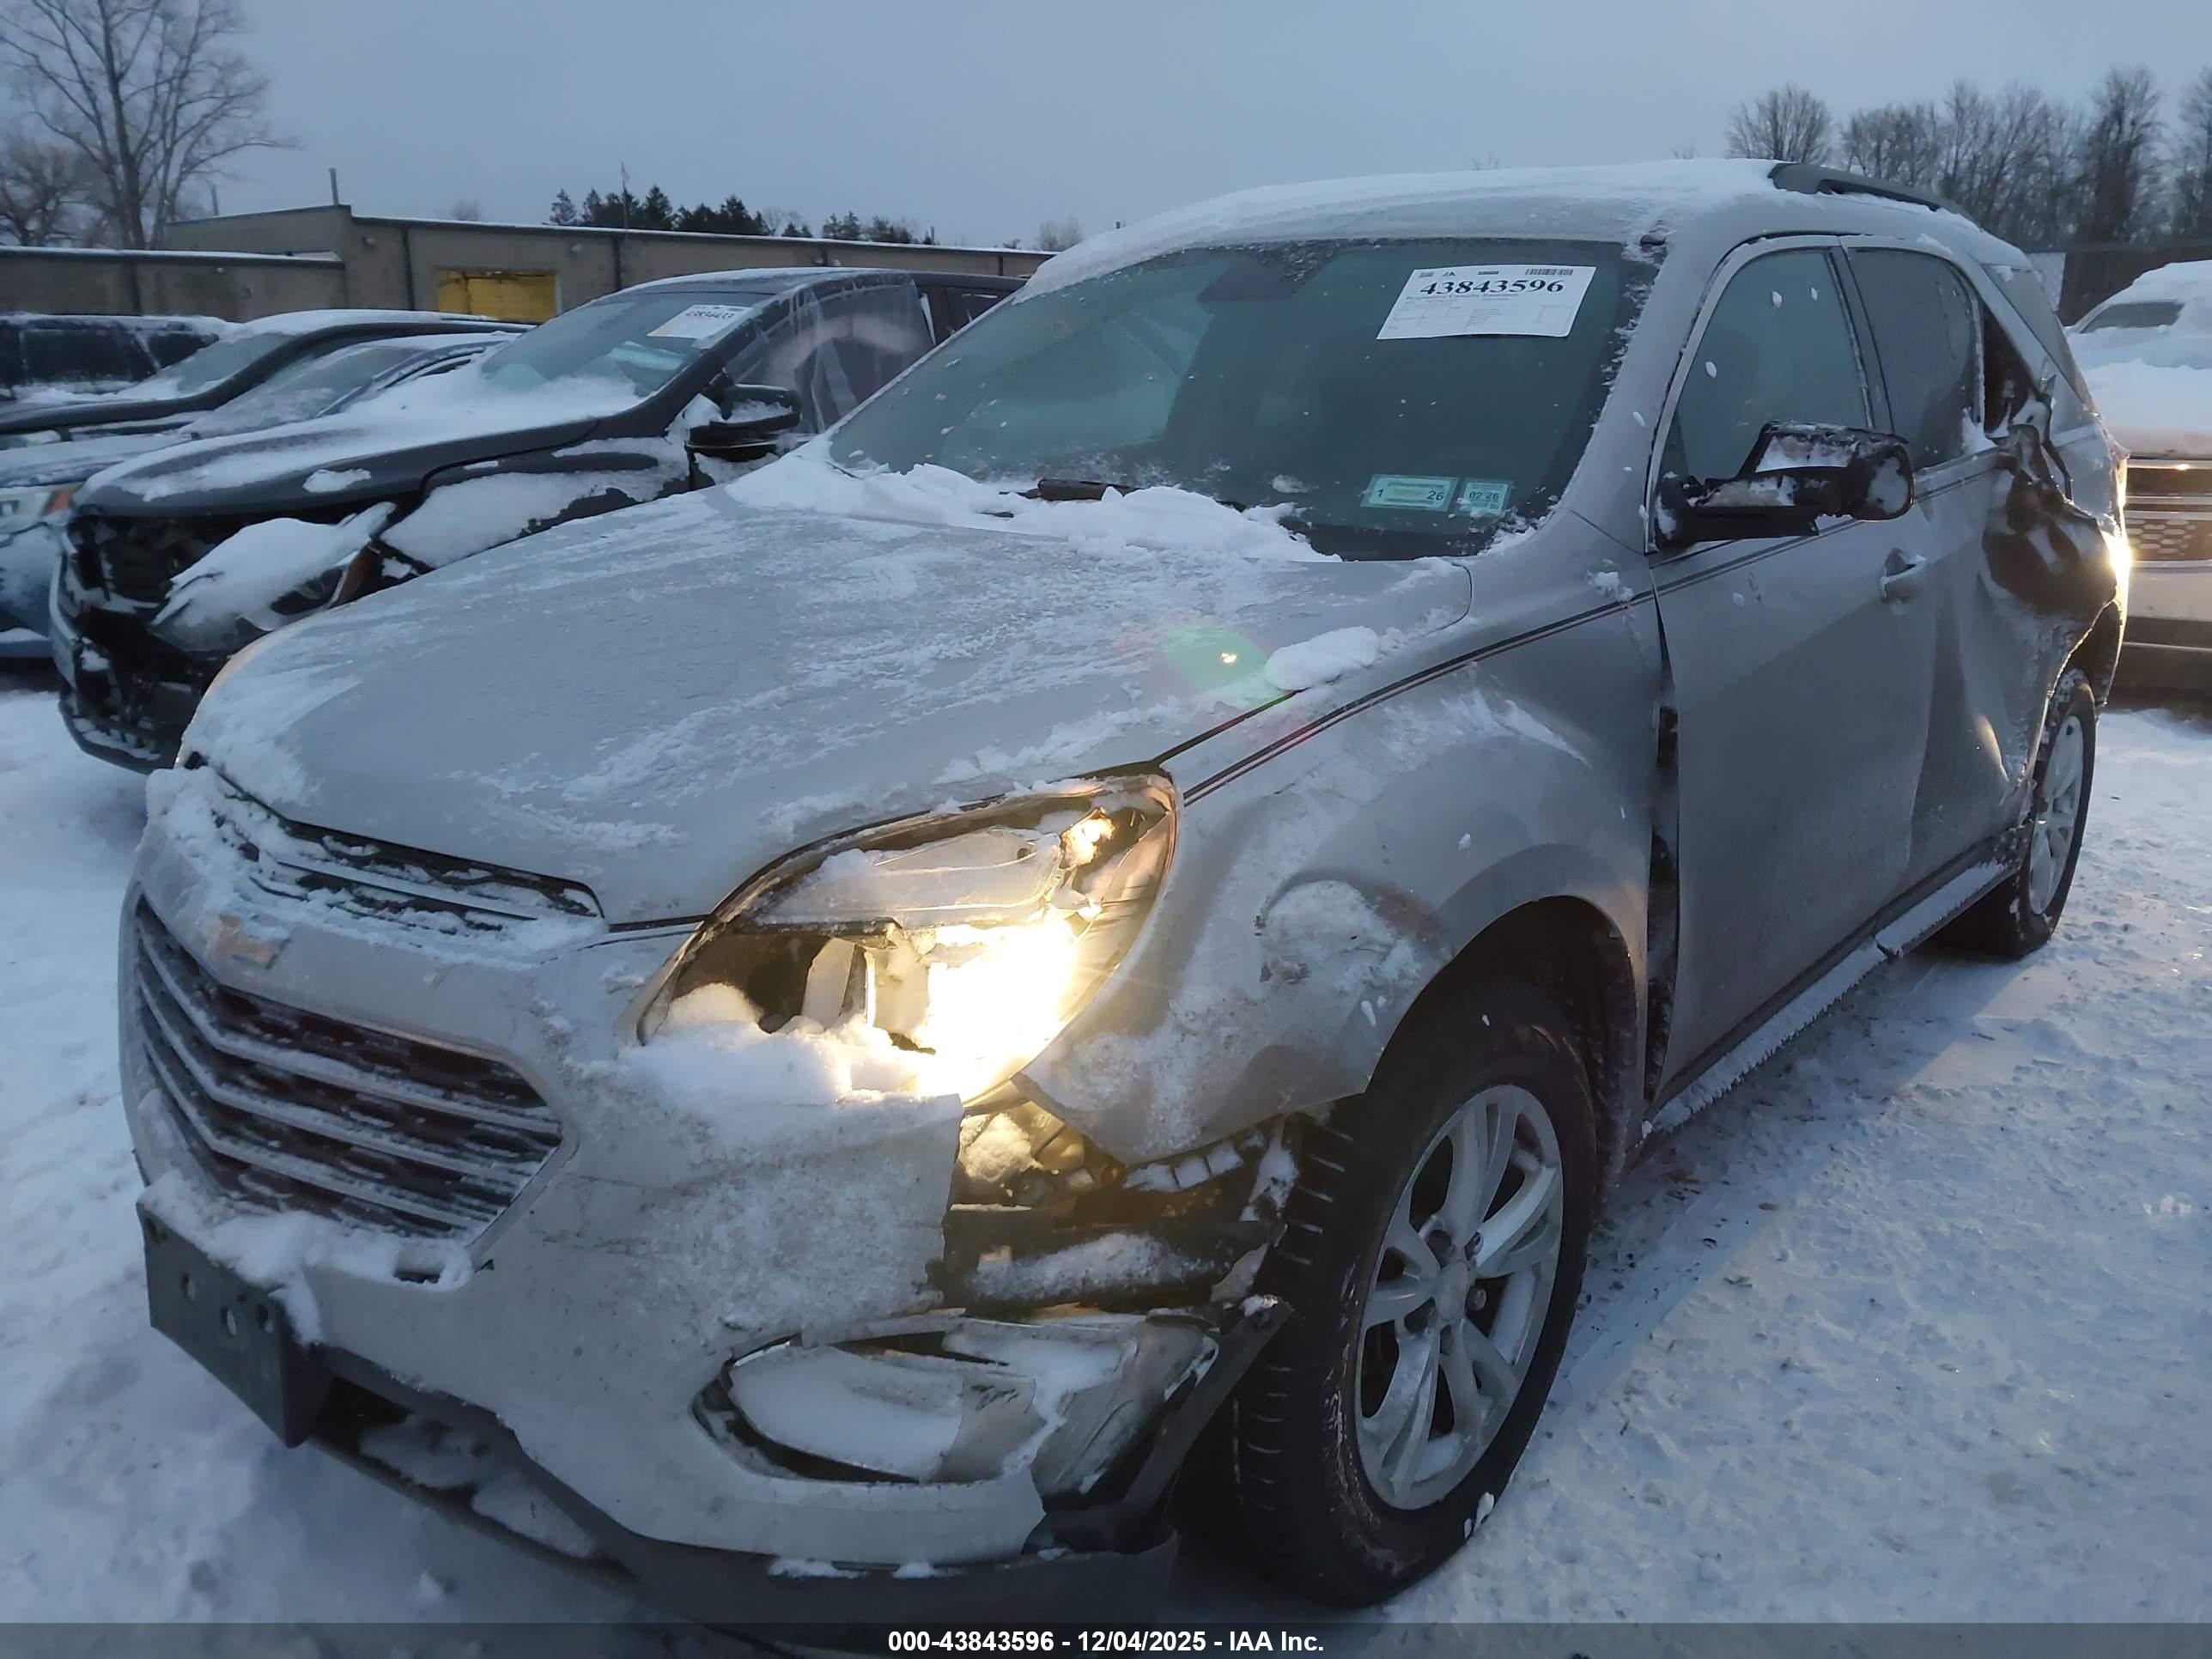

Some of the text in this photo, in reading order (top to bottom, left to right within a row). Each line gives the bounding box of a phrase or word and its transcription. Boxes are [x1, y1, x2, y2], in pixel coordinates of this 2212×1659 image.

[1420, 280, 1566, 295] 43843596
[1426, 489, 1444, 501] 26
[1486, 492, 1499, 501] 26
